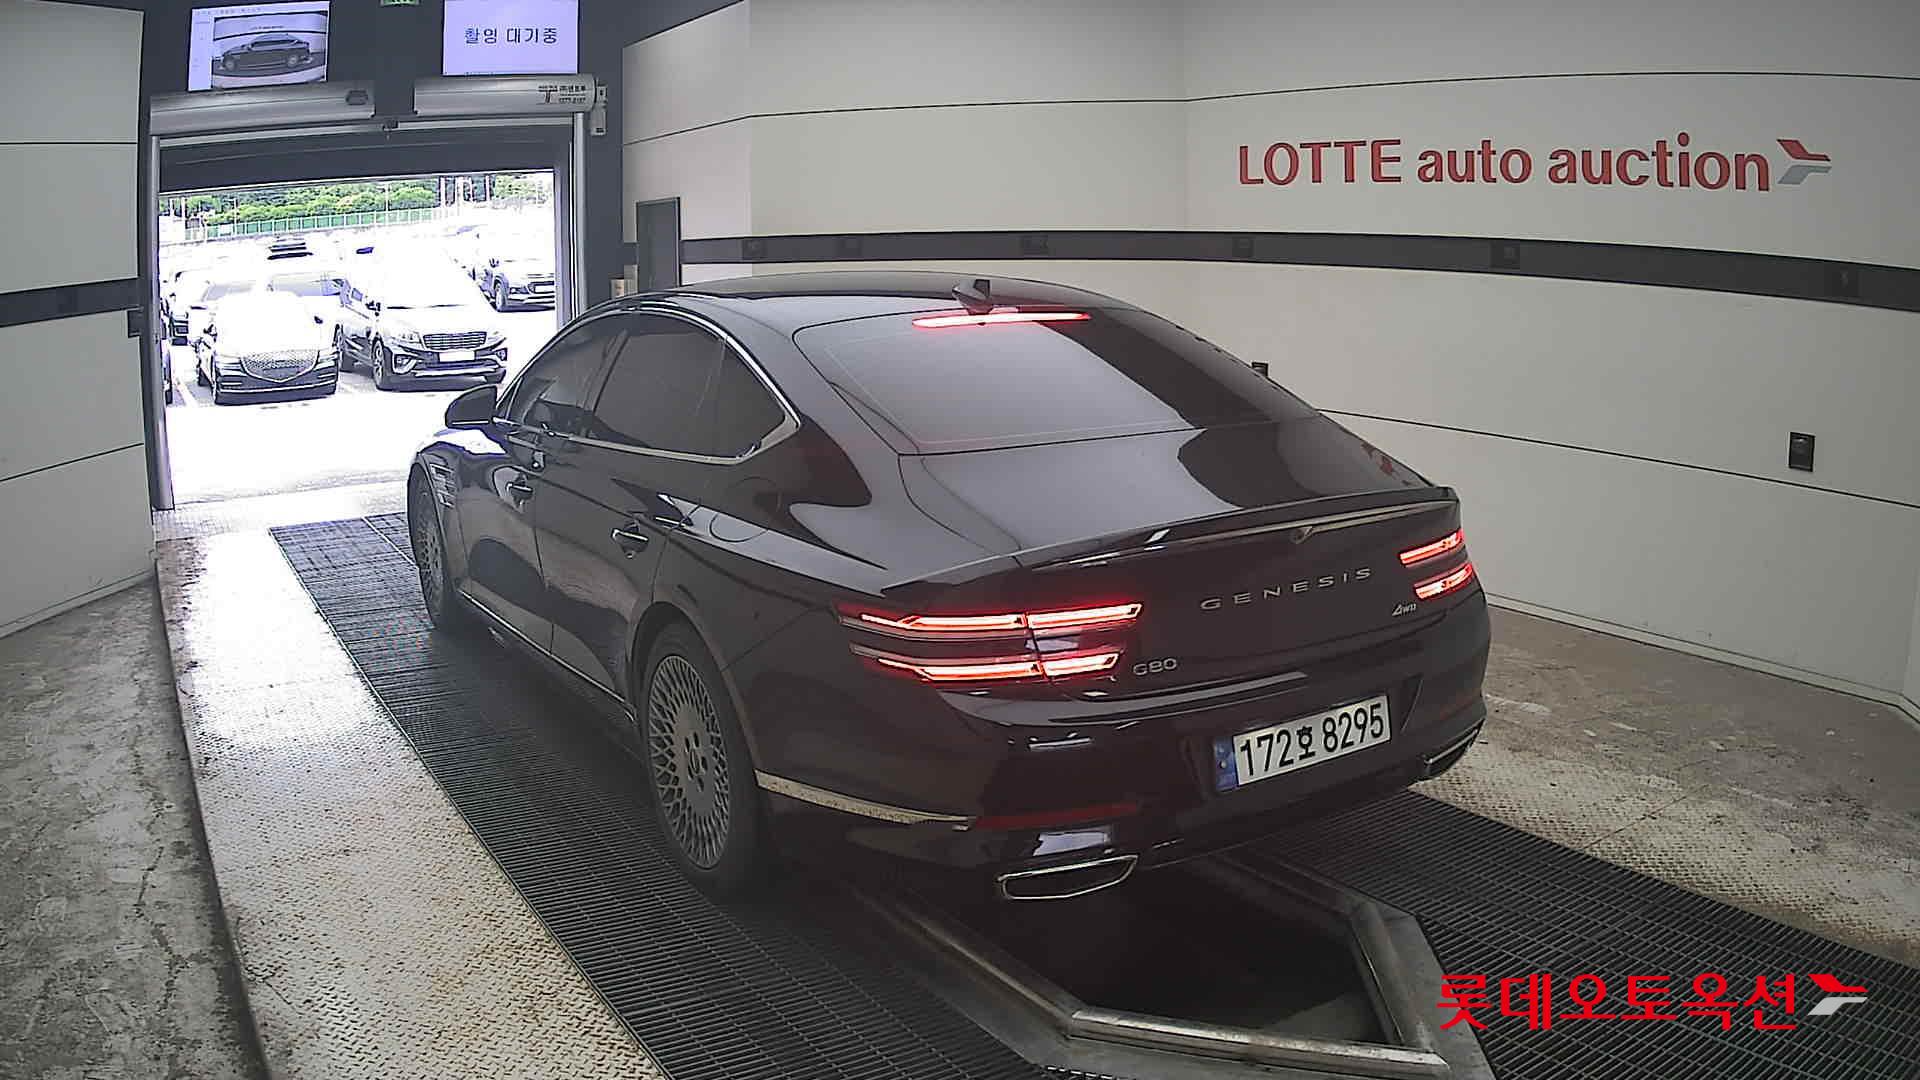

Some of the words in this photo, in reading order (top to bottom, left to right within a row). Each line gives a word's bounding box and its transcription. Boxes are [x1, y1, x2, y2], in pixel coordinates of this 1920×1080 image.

[1239, 139, 1401, 186] LOTTE
[1417, 140, 1533, 184] auto
[1548, 132, 1771, 191] auction
[1200, 567, 1371, 610] GENESIS
[1133, 657, 1178, 676] G80
[1240, 725, 1316, 776] 172호
[1322, 703, 1384, 752] 8295
